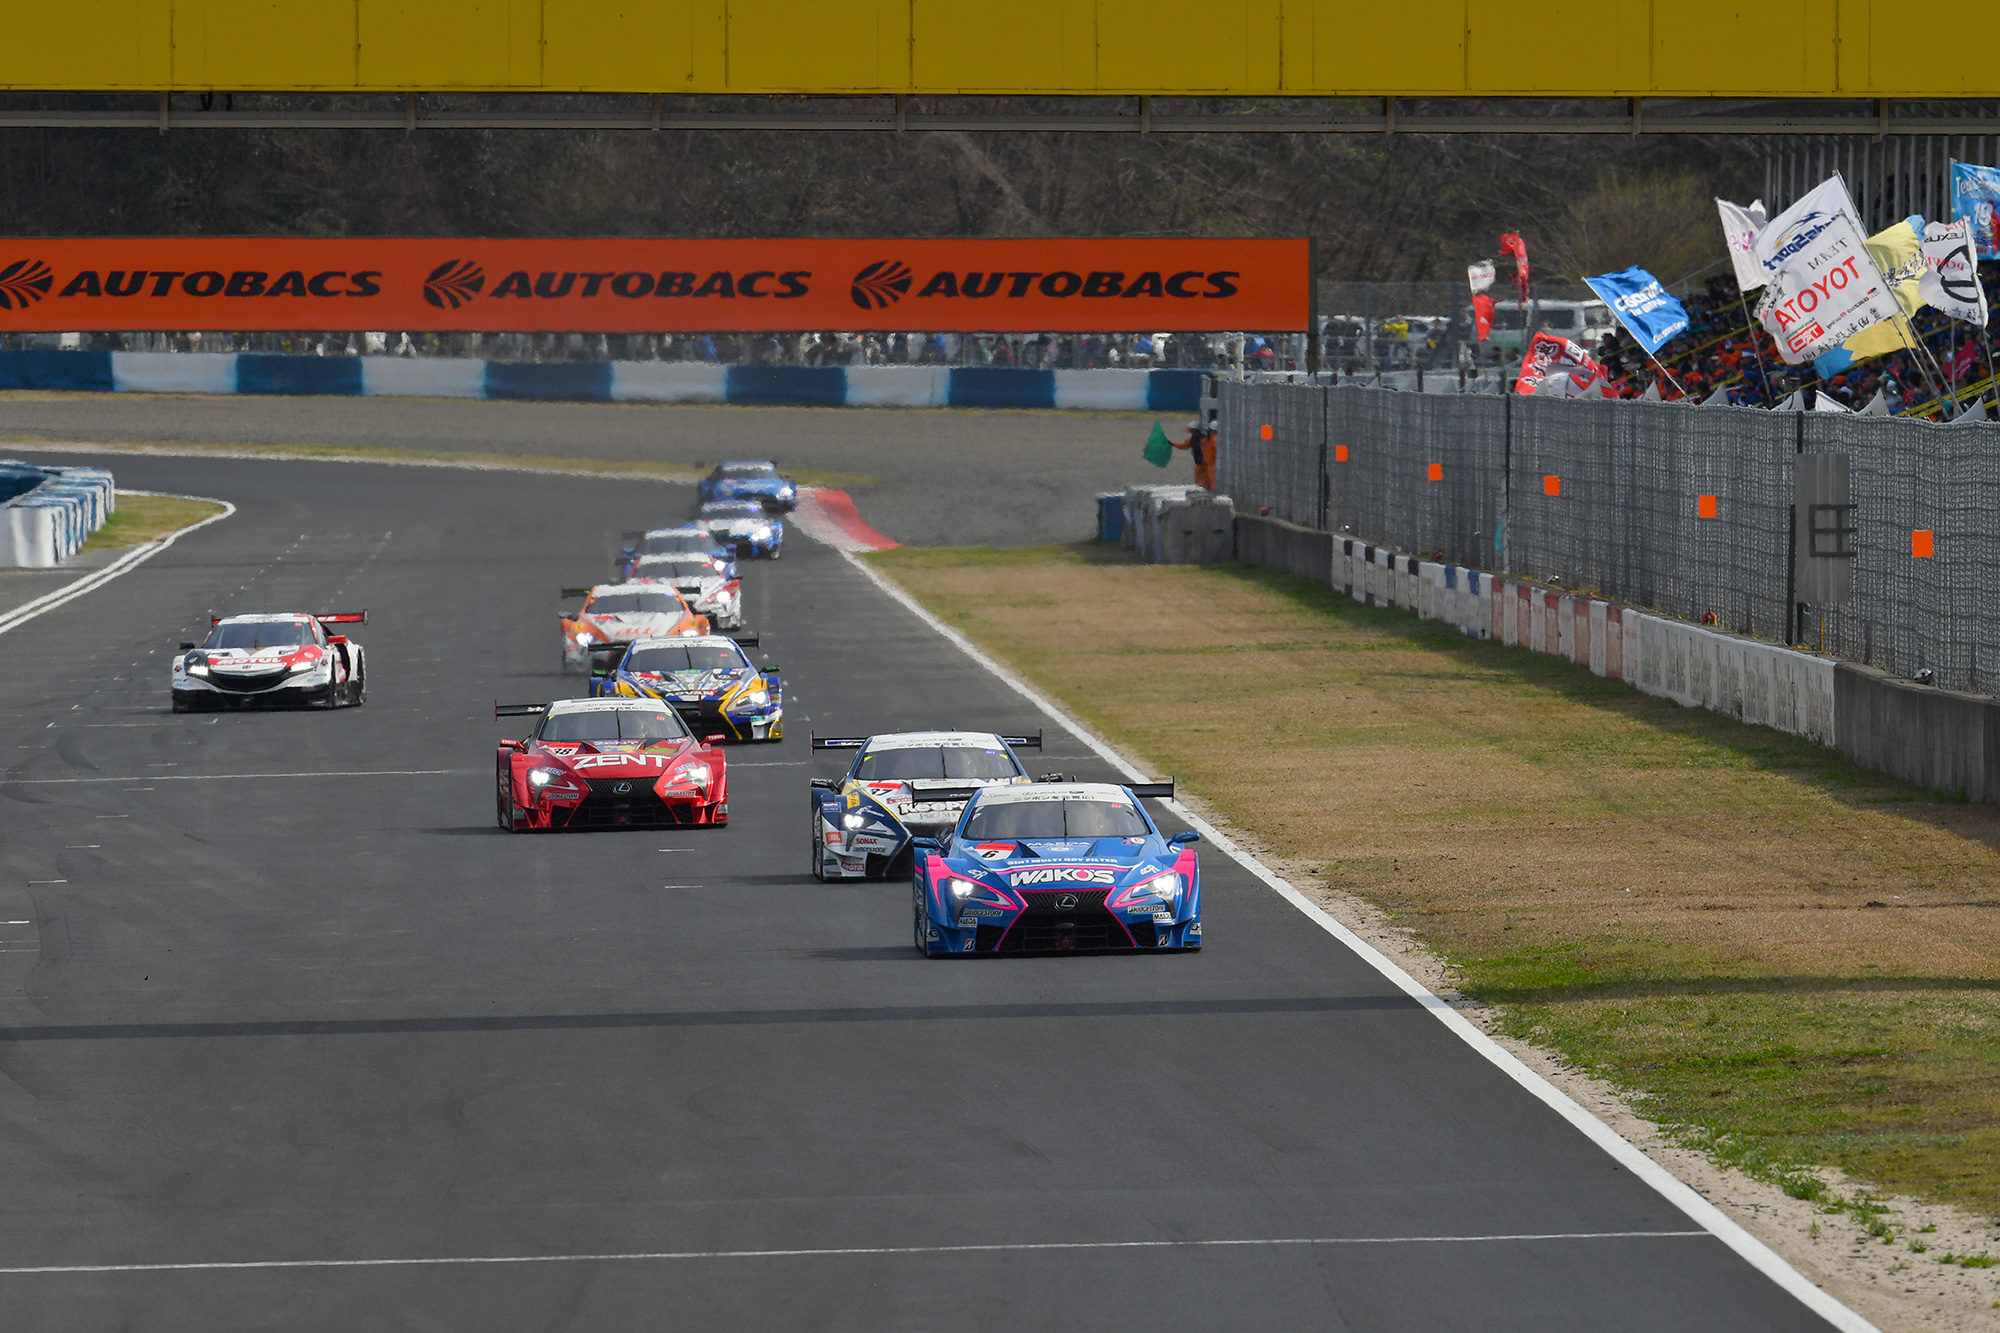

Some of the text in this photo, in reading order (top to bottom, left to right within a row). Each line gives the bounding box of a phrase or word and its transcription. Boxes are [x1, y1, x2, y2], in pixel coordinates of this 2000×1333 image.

[59, 271, 381, 297] AUTOBACS
[489, 271, 812, 298] AUTOBACS
[917, 271, 1240, 298] AUTOBACS
[573, 754, 672, 770] ZENT
[981, 850, 999, 859] 6
